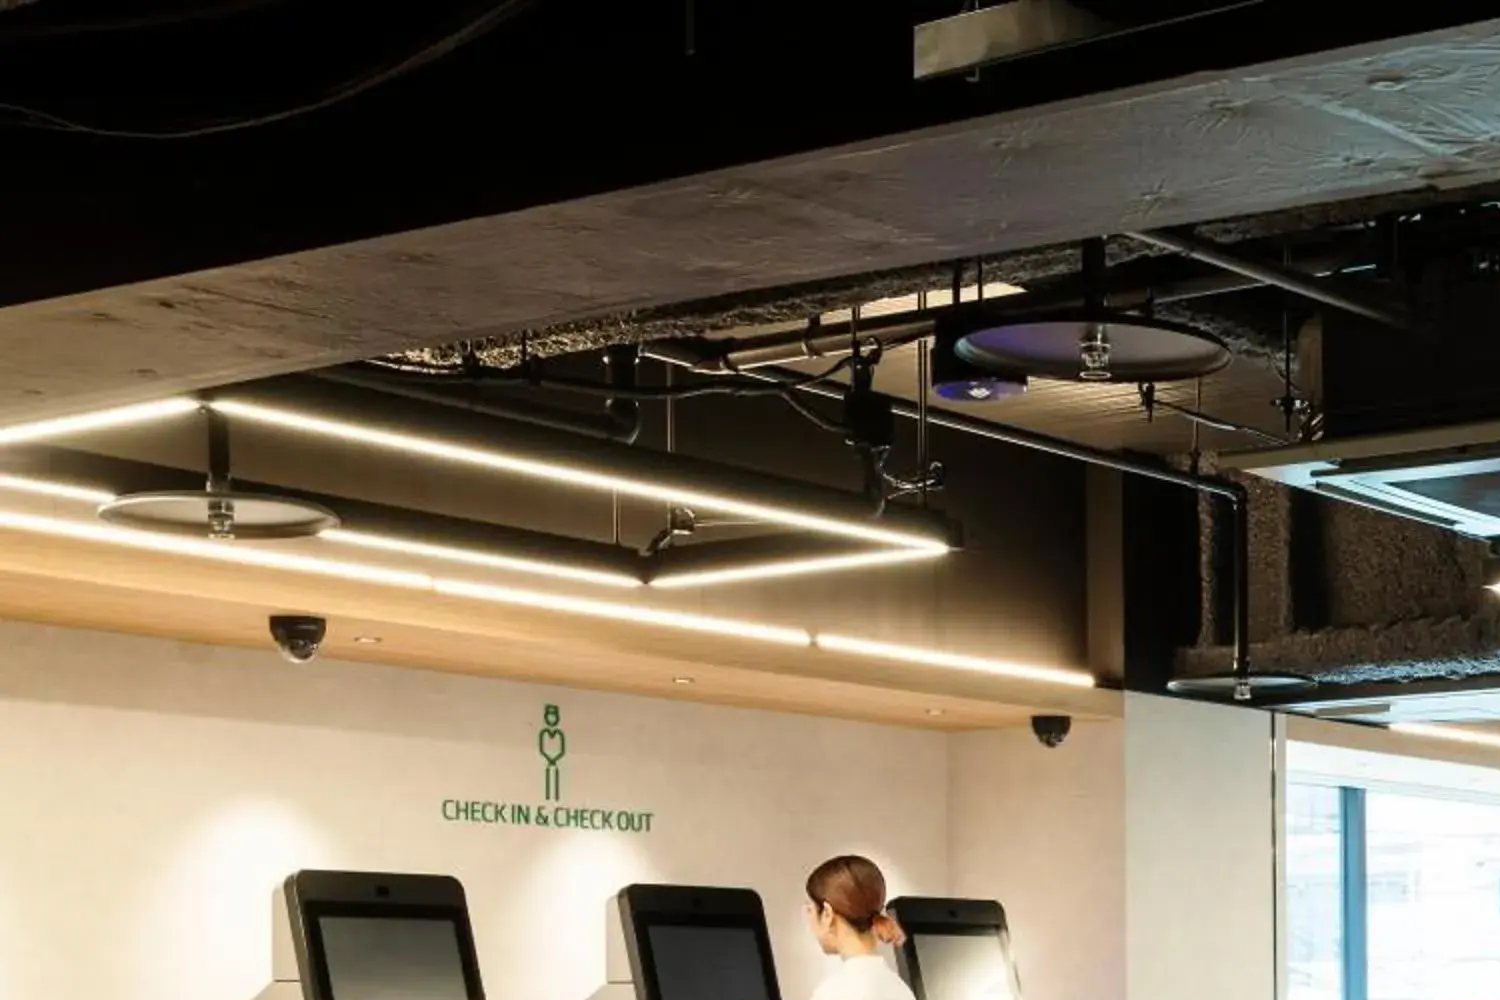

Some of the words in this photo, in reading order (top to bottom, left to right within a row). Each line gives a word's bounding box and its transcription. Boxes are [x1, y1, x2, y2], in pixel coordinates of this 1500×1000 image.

[441, 799, 506, 823] CHECK
[510, 804, 530, 825] IN
[535, 806, 550, 827] &
[553, 807, 613, 831] CHECK
[616, 811, 654, 833] OUT
